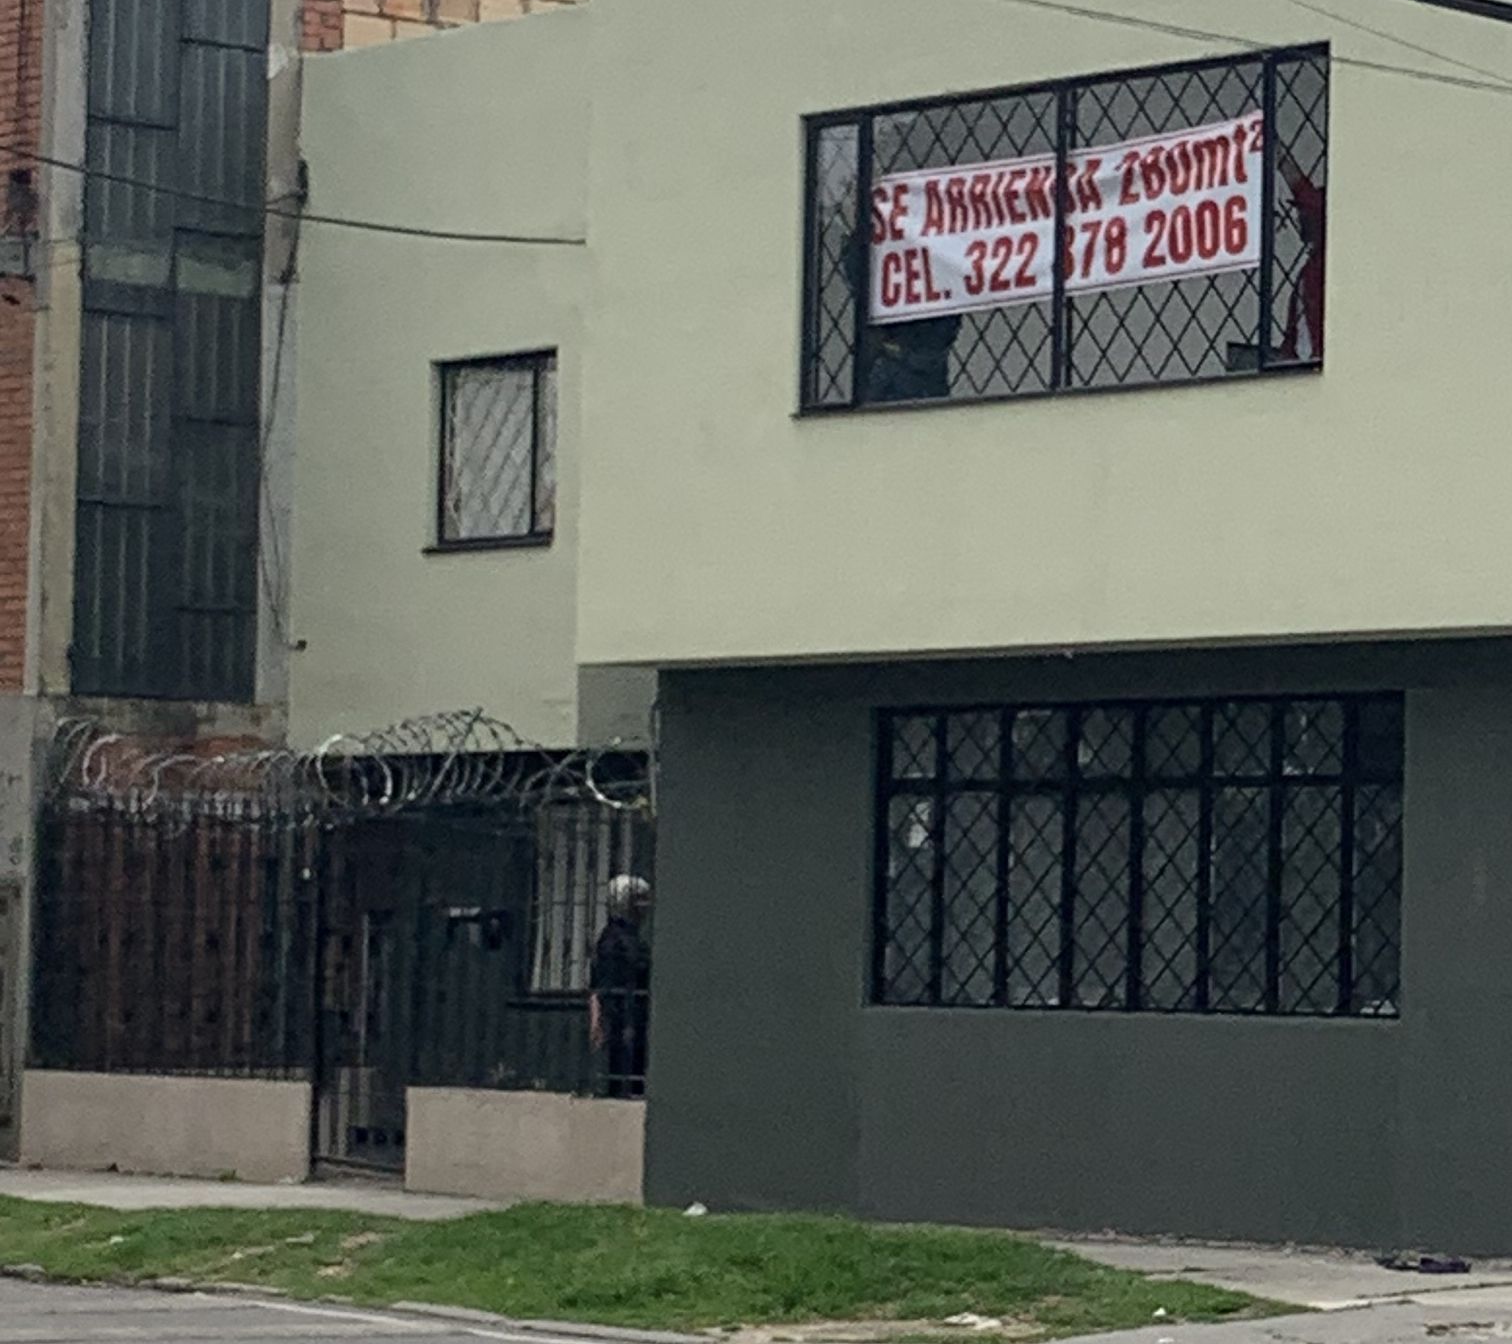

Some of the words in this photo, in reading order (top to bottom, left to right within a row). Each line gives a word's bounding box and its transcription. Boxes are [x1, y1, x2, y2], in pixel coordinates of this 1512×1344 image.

[871, 182, 909, 245] SE
[881, 247, 952, 308] CEL.
[964, 231, 1038, 295] 322
[1142, 195, 1248, 269] 2006
